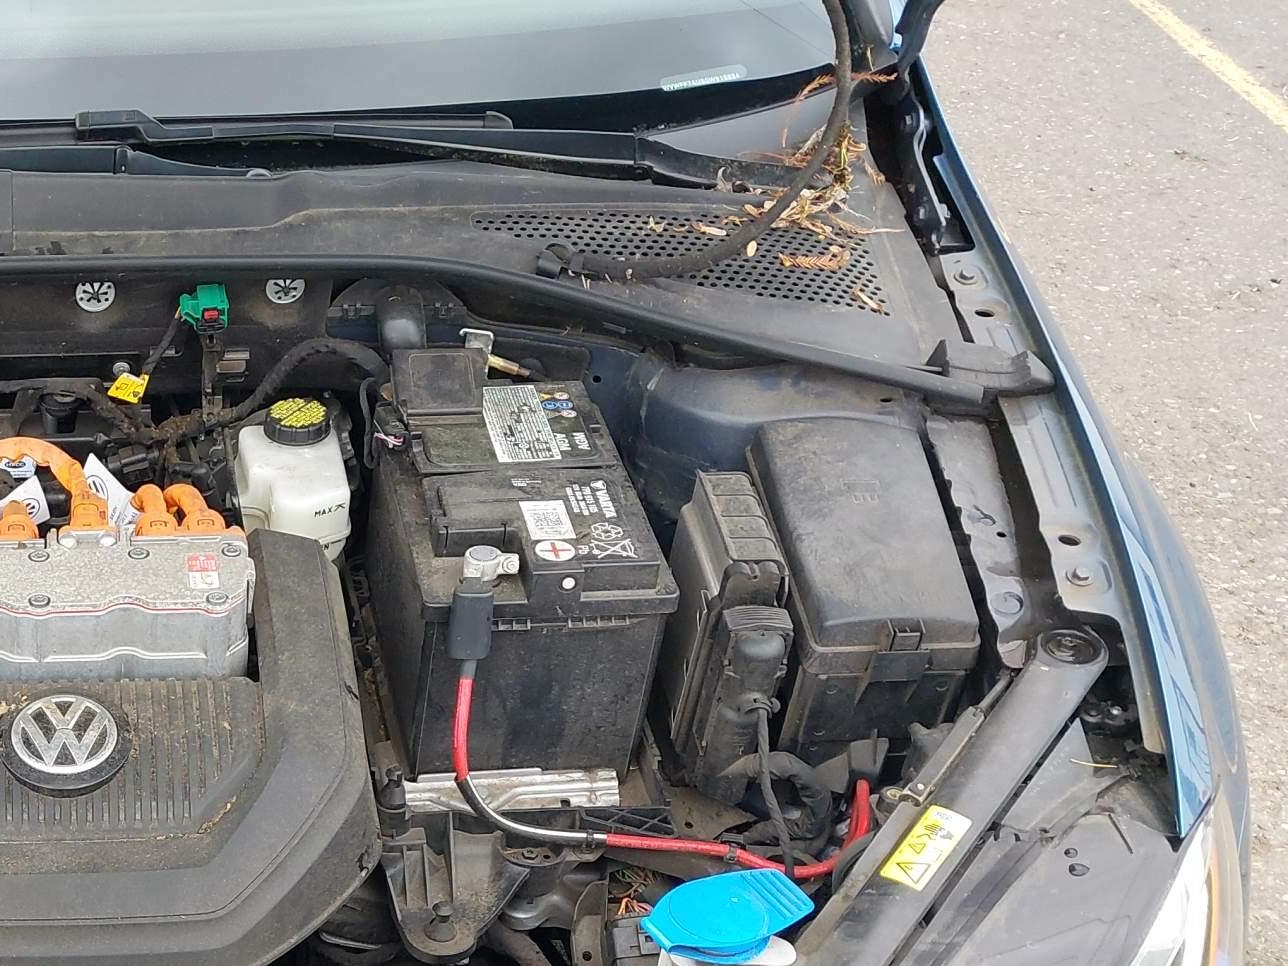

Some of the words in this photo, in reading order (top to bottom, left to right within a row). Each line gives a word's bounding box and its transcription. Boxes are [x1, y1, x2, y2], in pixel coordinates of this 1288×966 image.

[554, 432, 572, 451] AGM
[572, 432, 592, 450] AGM
[314, 506, 333, 518] MAX
[596, 490, 617, 518] VARTA
[577, 545, 590, 555] Pb
